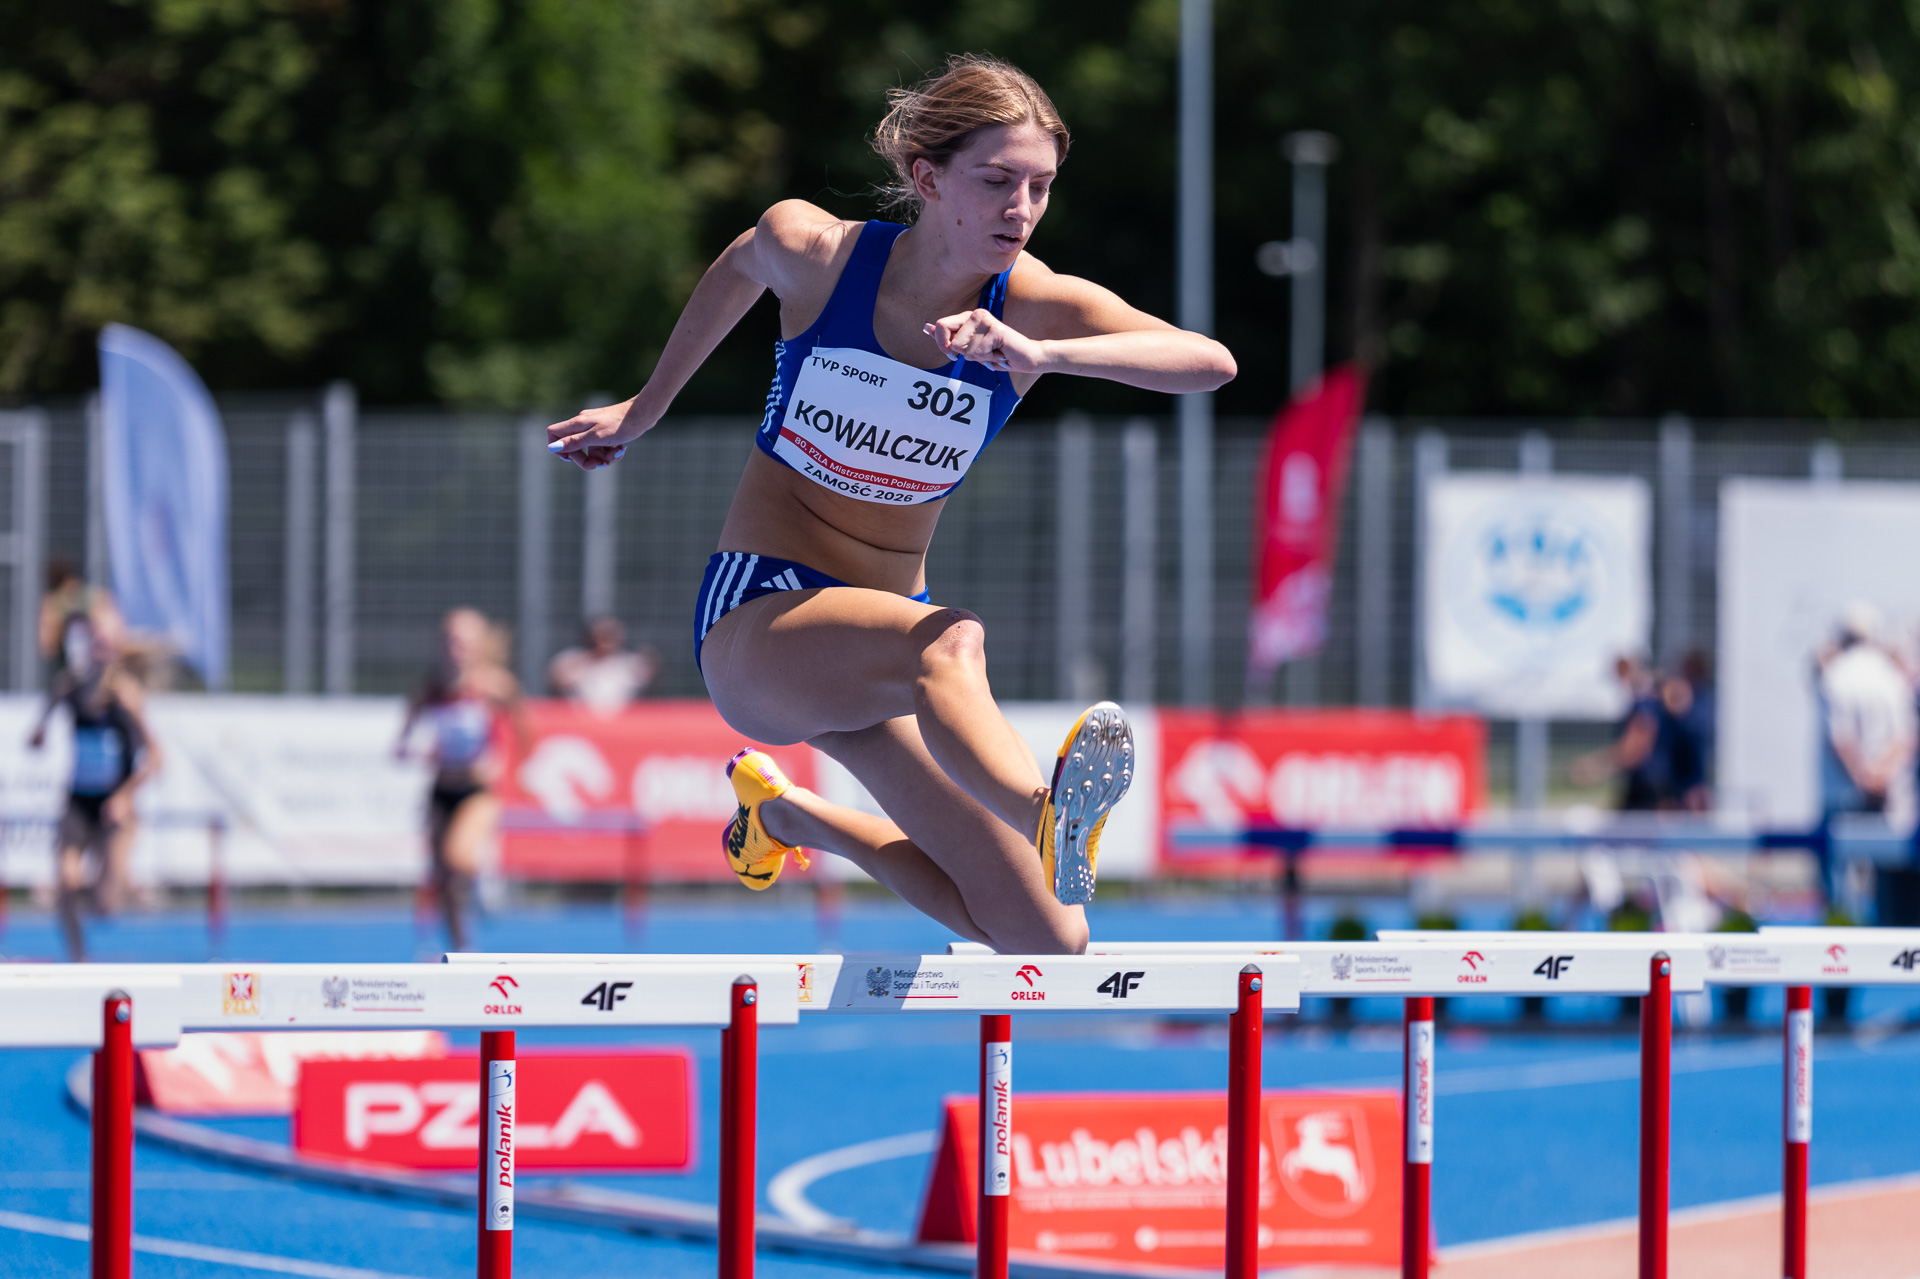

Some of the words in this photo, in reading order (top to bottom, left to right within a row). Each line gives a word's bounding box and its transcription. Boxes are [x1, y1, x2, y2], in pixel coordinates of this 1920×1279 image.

[812, 356, 840, 372] TVP
[841, 365, 888, 388] SPORT
[907, 380, 976, 425] 302
[794, 399, 969, 471] KOWALCZUK
[794, 436, 808, 451] 80.
[808, 447, 828, 466] PZLA
[829, 462, 888, 485] Mistrzostwa
[890, 478, 921, 491] Polski
[803, 461, 872, 497] ZAMOŚĆ
[874, 489, 914, 502] 2026
[894, 970, 944, 979] Ministerstwo
[1457, 975, 1488, 983] ORLEN
[1533, 955, 1574, 980] 4F
[352, 979, 409, 989] Ministerstwo
[352, 991, 380, 1001] Sportu
[387, 990, 425, 1003] Turystyki
[581, 981, 633, 1011] 4F
[893, 980, 920, 990] Sportu
[925, 980, 960, 990] Turystyki
[1011, 991, 1045, 1001] ORLEN
[1097, 971, 1146, 998] 4F
[223, 1002, 260, 1015] PZLA
[484, 1005, 522, 1015] ORLEN
[993, 1079, 1009, 1156] polanik
[494, 1102, 513, 1188] polanik
[1011, 1126, 1270, 1188] Lubelski
